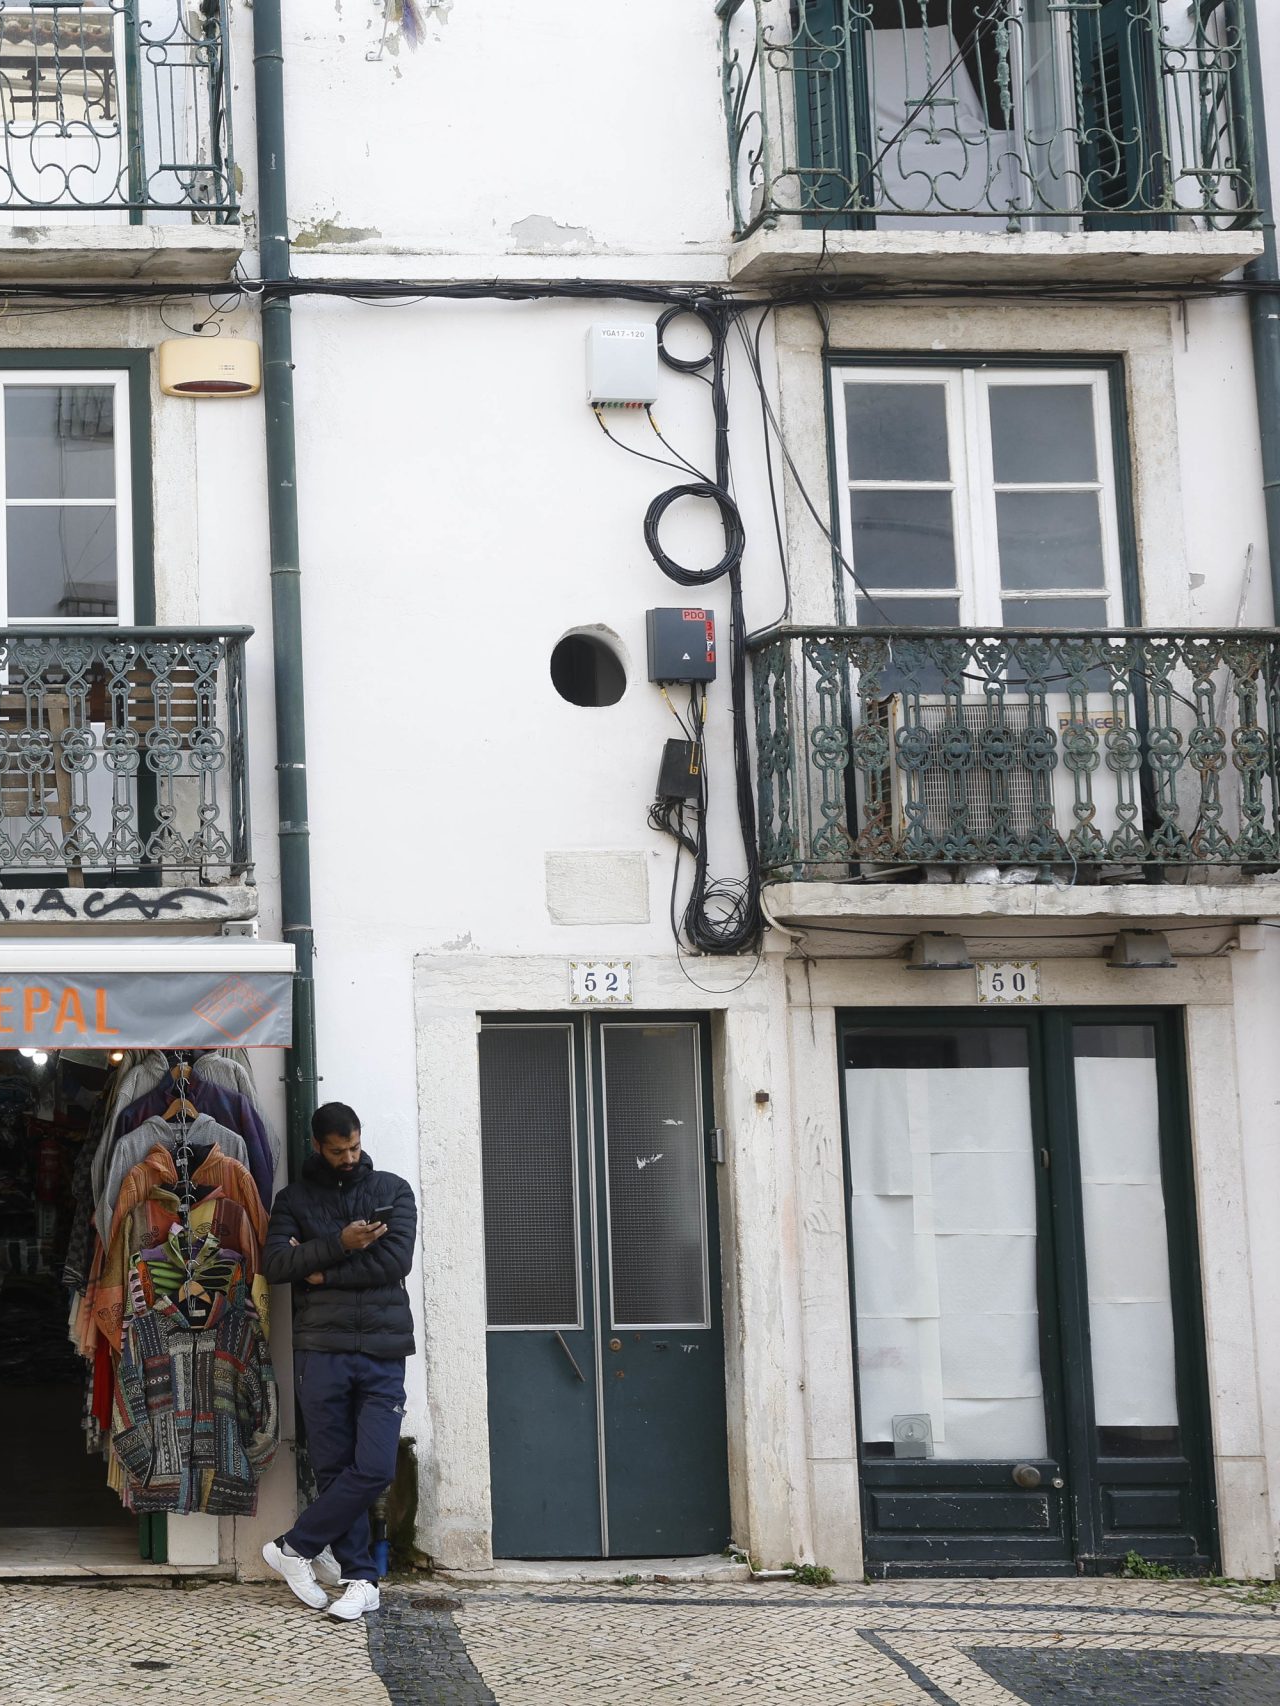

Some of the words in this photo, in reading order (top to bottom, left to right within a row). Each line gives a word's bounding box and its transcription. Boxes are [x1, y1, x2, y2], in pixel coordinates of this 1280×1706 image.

[602, 329, 645, 338] YGA17-120
[683, 611, 705, 620] PDO
[1059, 717, 1124, 730] PINEER
[584, 972, 619, 992] 52
[991, 972, 1026, 992] 50
